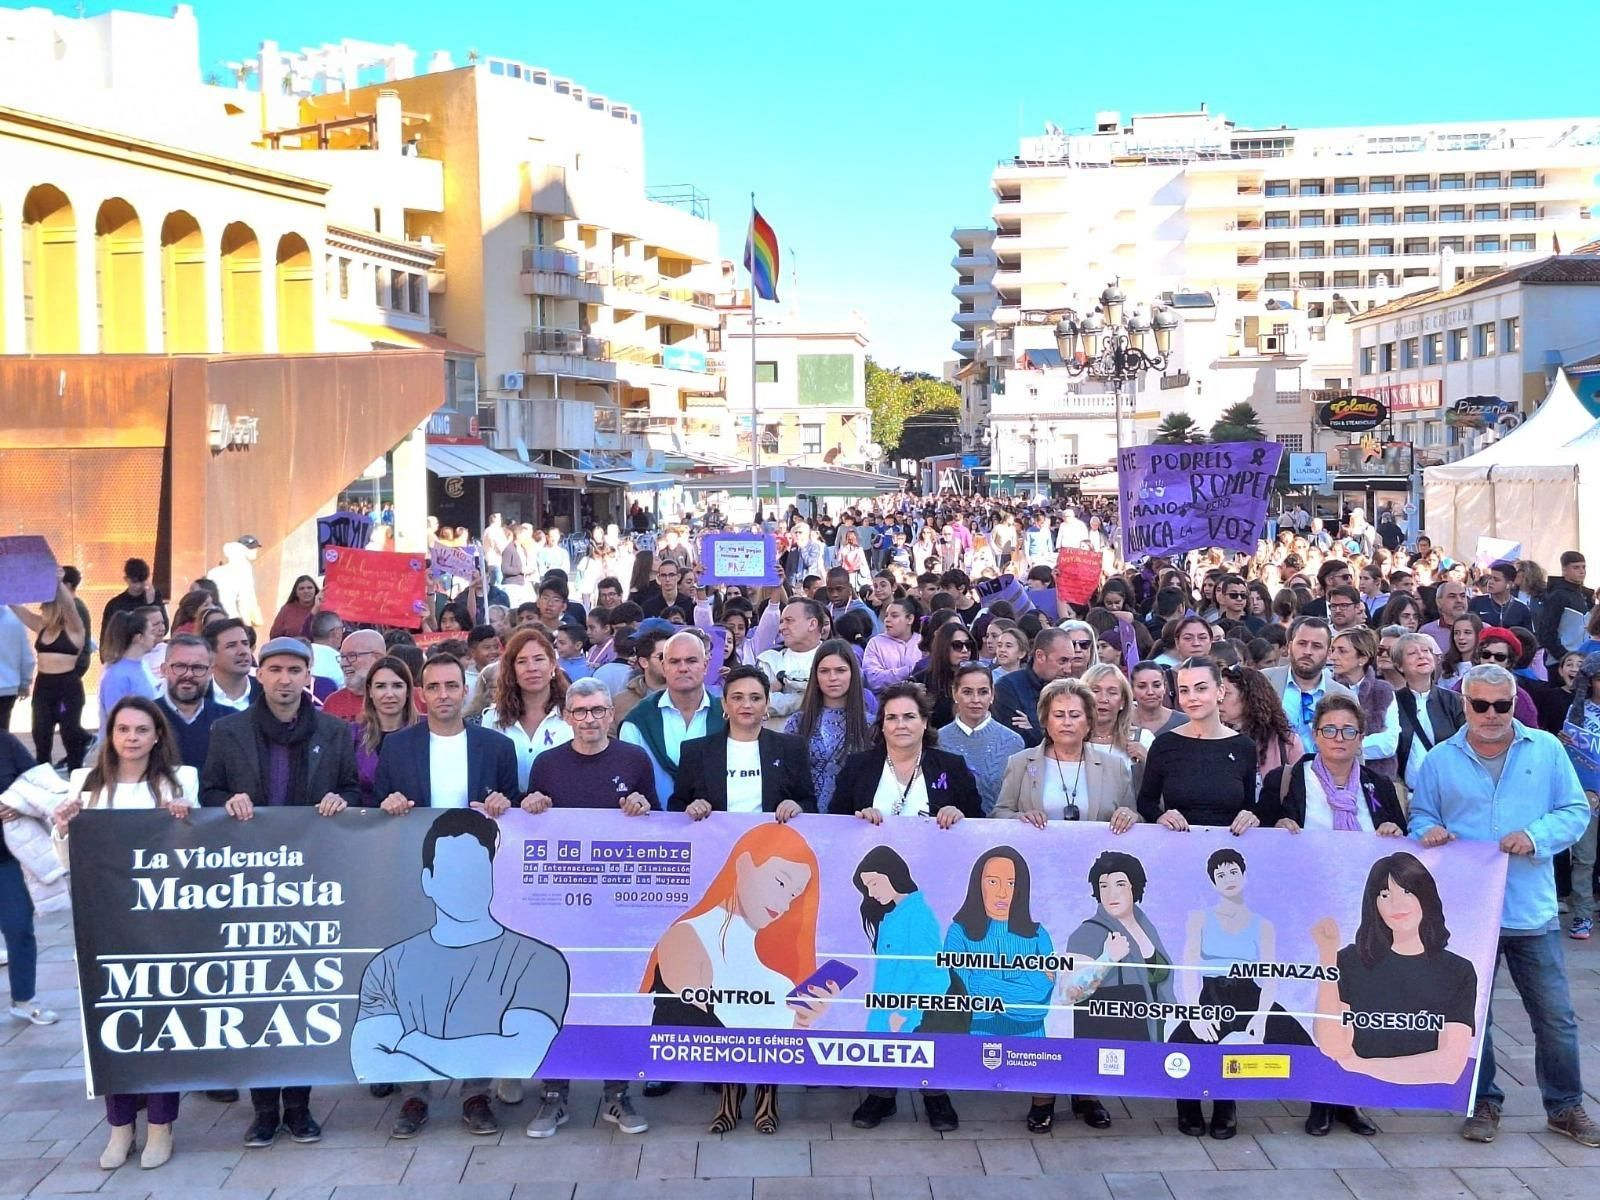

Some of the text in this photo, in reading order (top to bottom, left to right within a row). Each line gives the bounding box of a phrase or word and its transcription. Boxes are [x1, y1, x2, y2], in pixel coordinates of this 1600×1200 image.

[1122, 453, 1136, 471] ME
[1180, 526, 1192, 538] LA
[1208, 516, 1256, 546] VOZ
[132, 845, 304, 869] La Violencia
[526, 845, 690, 859] 25 de noviembre
[543, 863, 605, 872] Internacional
[610, 864, 620, 872] de
[624, 864, 634, 872] la
[638, 864, 690, 873] Eliminación
[523, 876, 533, 884] de
[538, 876, 548, 884] la
[553, 875, 598, 884] Violencia
[602, 876, 631, 884] Contra
[656, 876, 690, 885] Mujeres
[131, 872, 345, 910] Machista
[565, 893, 592, 906] 016
[615, 892, 689, 902] 900 200 999
[220, 920, 341, 948] TIENE
[936, 953, 1074, 971] HUMILLACIÓN
[101, 957, 344, 999] MUCHAS
[1228, 963, 1339, 981] AMENAZAS
[681, 988, 775, 1005] CONTROL
[865, 994, 1005, 1012] INDIFERENCIA
[1089, 1001, 1236, 1020] MENOSPRECIO
[100, 1002, 342, 1053] CARAS
[1343, 1011, 1444, 1030] POSESIÓN
[650, 1033, 804, 1046] ANTE LA VIOLENCIA DE GÉNERO
[650, 1042, 928, 1064] TORREMOLINOS VIOLETA
[1007, 1050, 1062, 1061] Torremolinos
